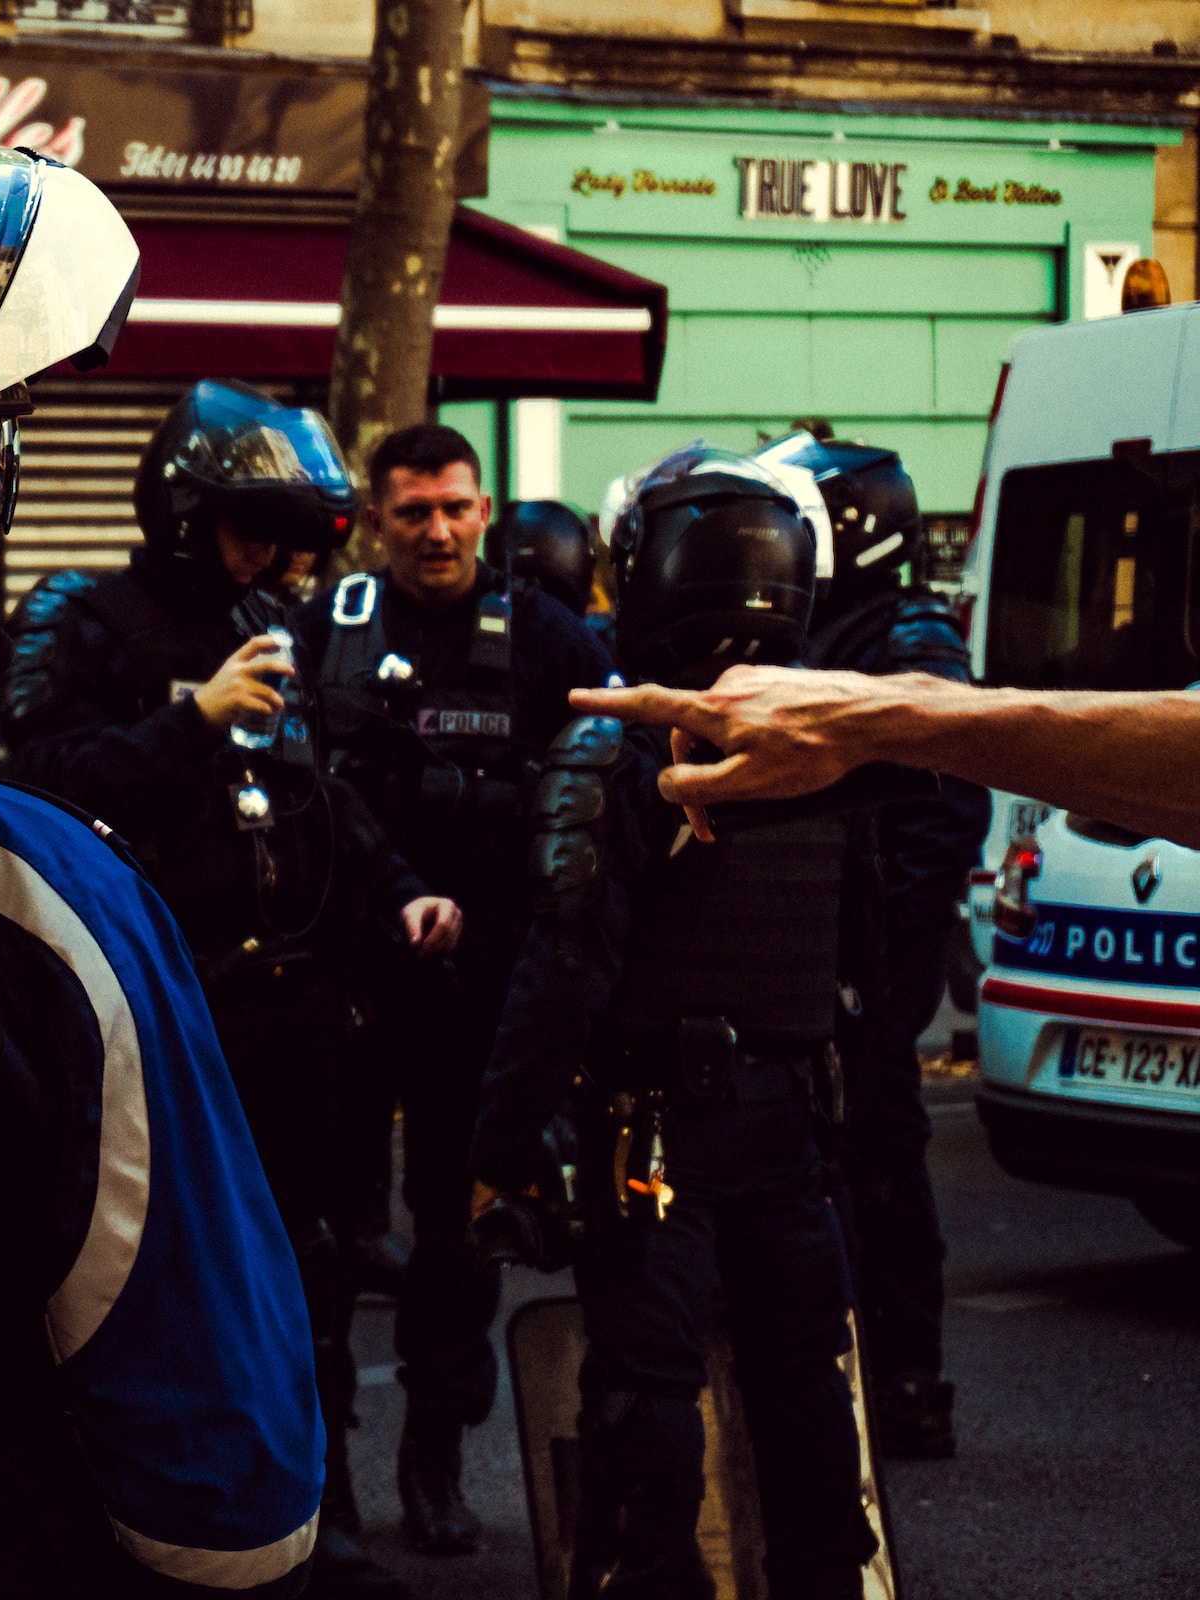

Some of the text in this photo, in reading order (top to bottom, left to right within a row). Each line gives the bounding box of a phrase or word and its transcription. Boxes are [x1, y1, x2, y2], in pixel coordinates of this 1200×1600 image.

[732, 157, 908, 221] TRUE LOVE
[442, 711, 506, 735] POLICE
